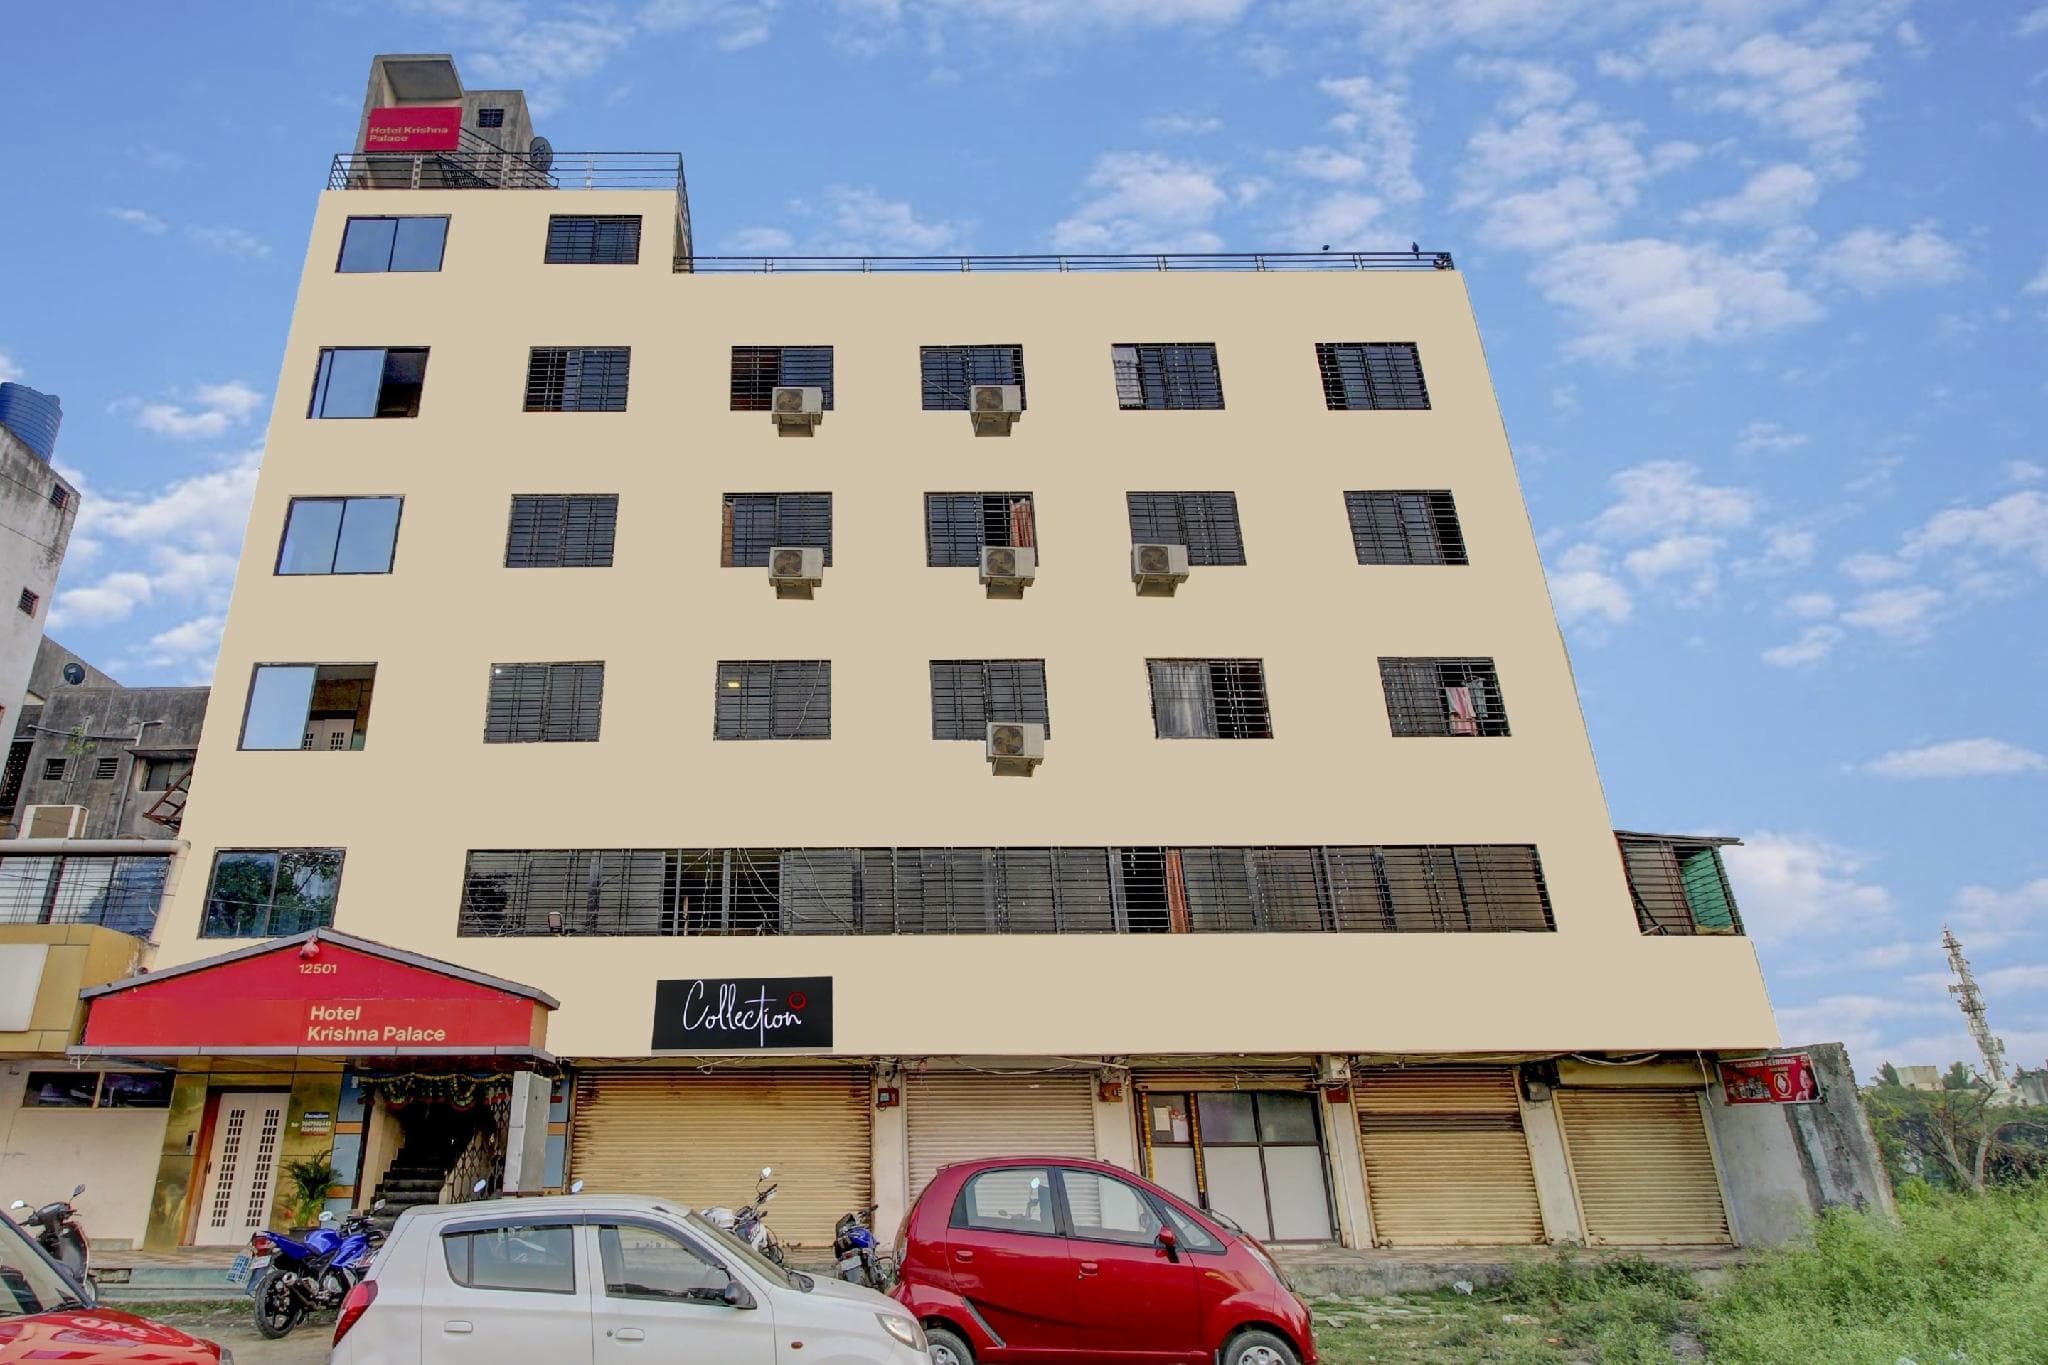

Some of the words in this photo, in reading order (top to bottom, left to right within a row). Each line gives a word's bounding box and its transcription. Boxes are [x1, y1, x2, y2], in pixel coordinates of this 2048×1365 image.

[403, 126, 448, 134] Krishna
[299, 963, 337, 974] 12501
[310, 1005, 362, 1021] Hotel
[682, 979, 803, 1048] Collection
[307, 1026, 379, 1041] Krishna
[383, 1026, 446, 1041] Palace
